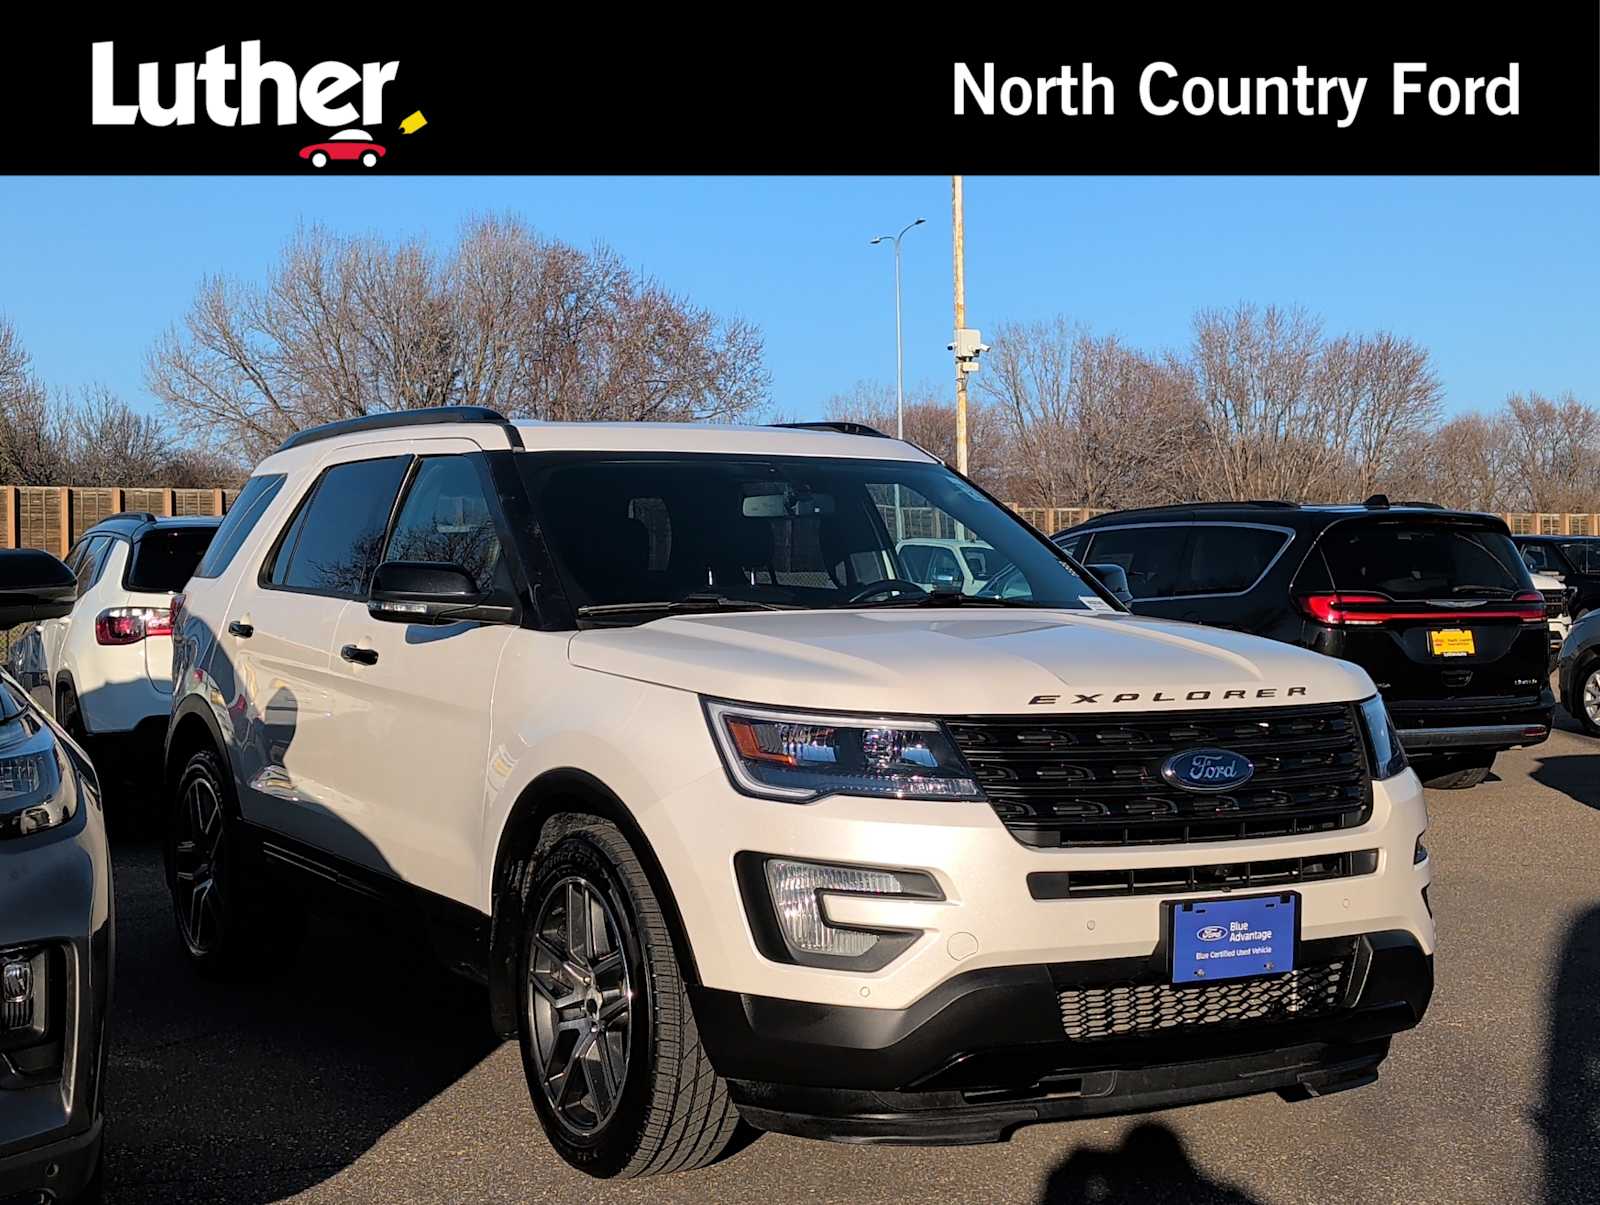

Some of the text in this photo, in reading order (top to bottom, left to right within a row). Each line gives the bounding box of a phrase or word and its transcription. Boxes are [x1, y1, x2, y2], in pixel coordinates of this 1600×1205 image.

[1028, 686, 1307, 705] EXPLORER
[1189, 755, 1237, 779] Ford
[1230, 921, 1249, 931] Blue
[1229, 930, 1273, 942] Advantage
[1210, 950, 1236, 958] Certified
[1252, 946, 1272, 954] Vehicle
